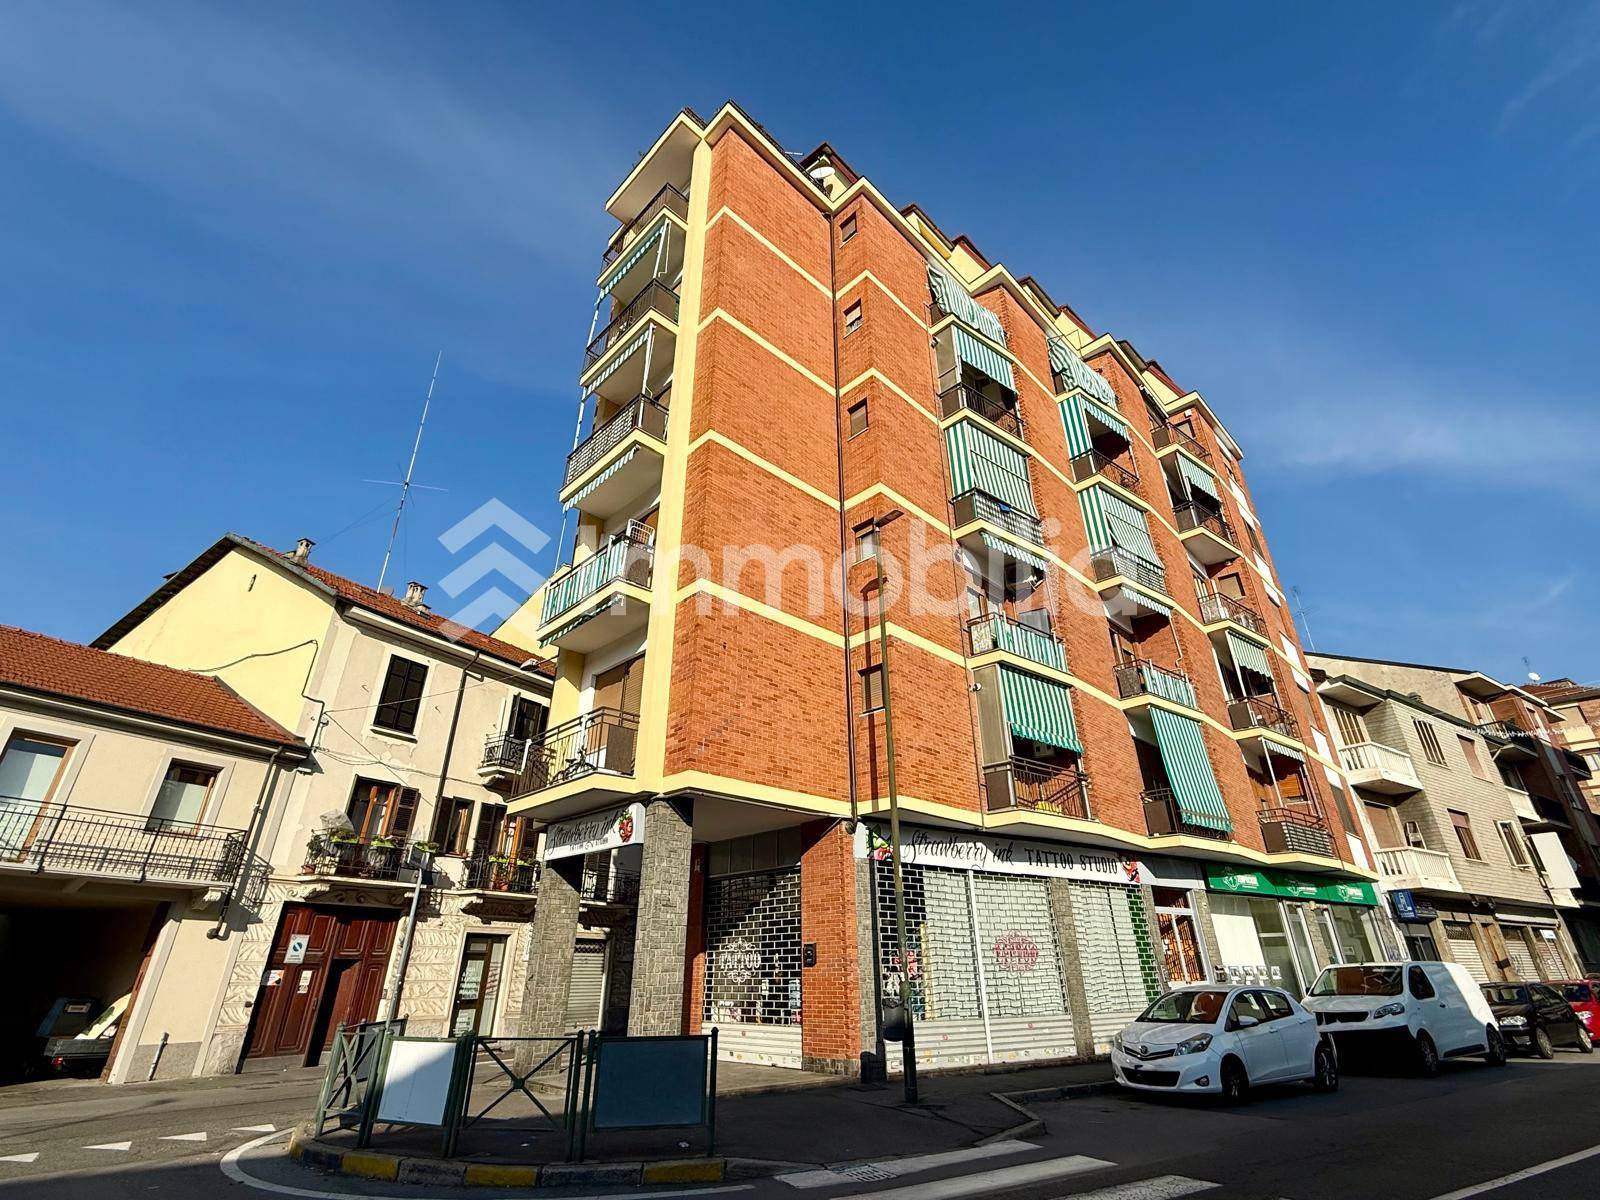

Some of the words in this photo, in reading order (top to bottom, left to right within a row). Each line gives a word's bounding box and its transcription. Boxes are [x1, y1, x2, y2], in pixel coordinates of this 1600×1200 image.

[601, 811, 617, 836] ink
[902, 830, 988, 870] Strawberry
[993, 841, 1013, 865] ink
[1024, 848, 1073, 870] TATTOO
[1080, 854, 1118, 874] STUDIO
[720, 952, 761, 969] TATTOO
